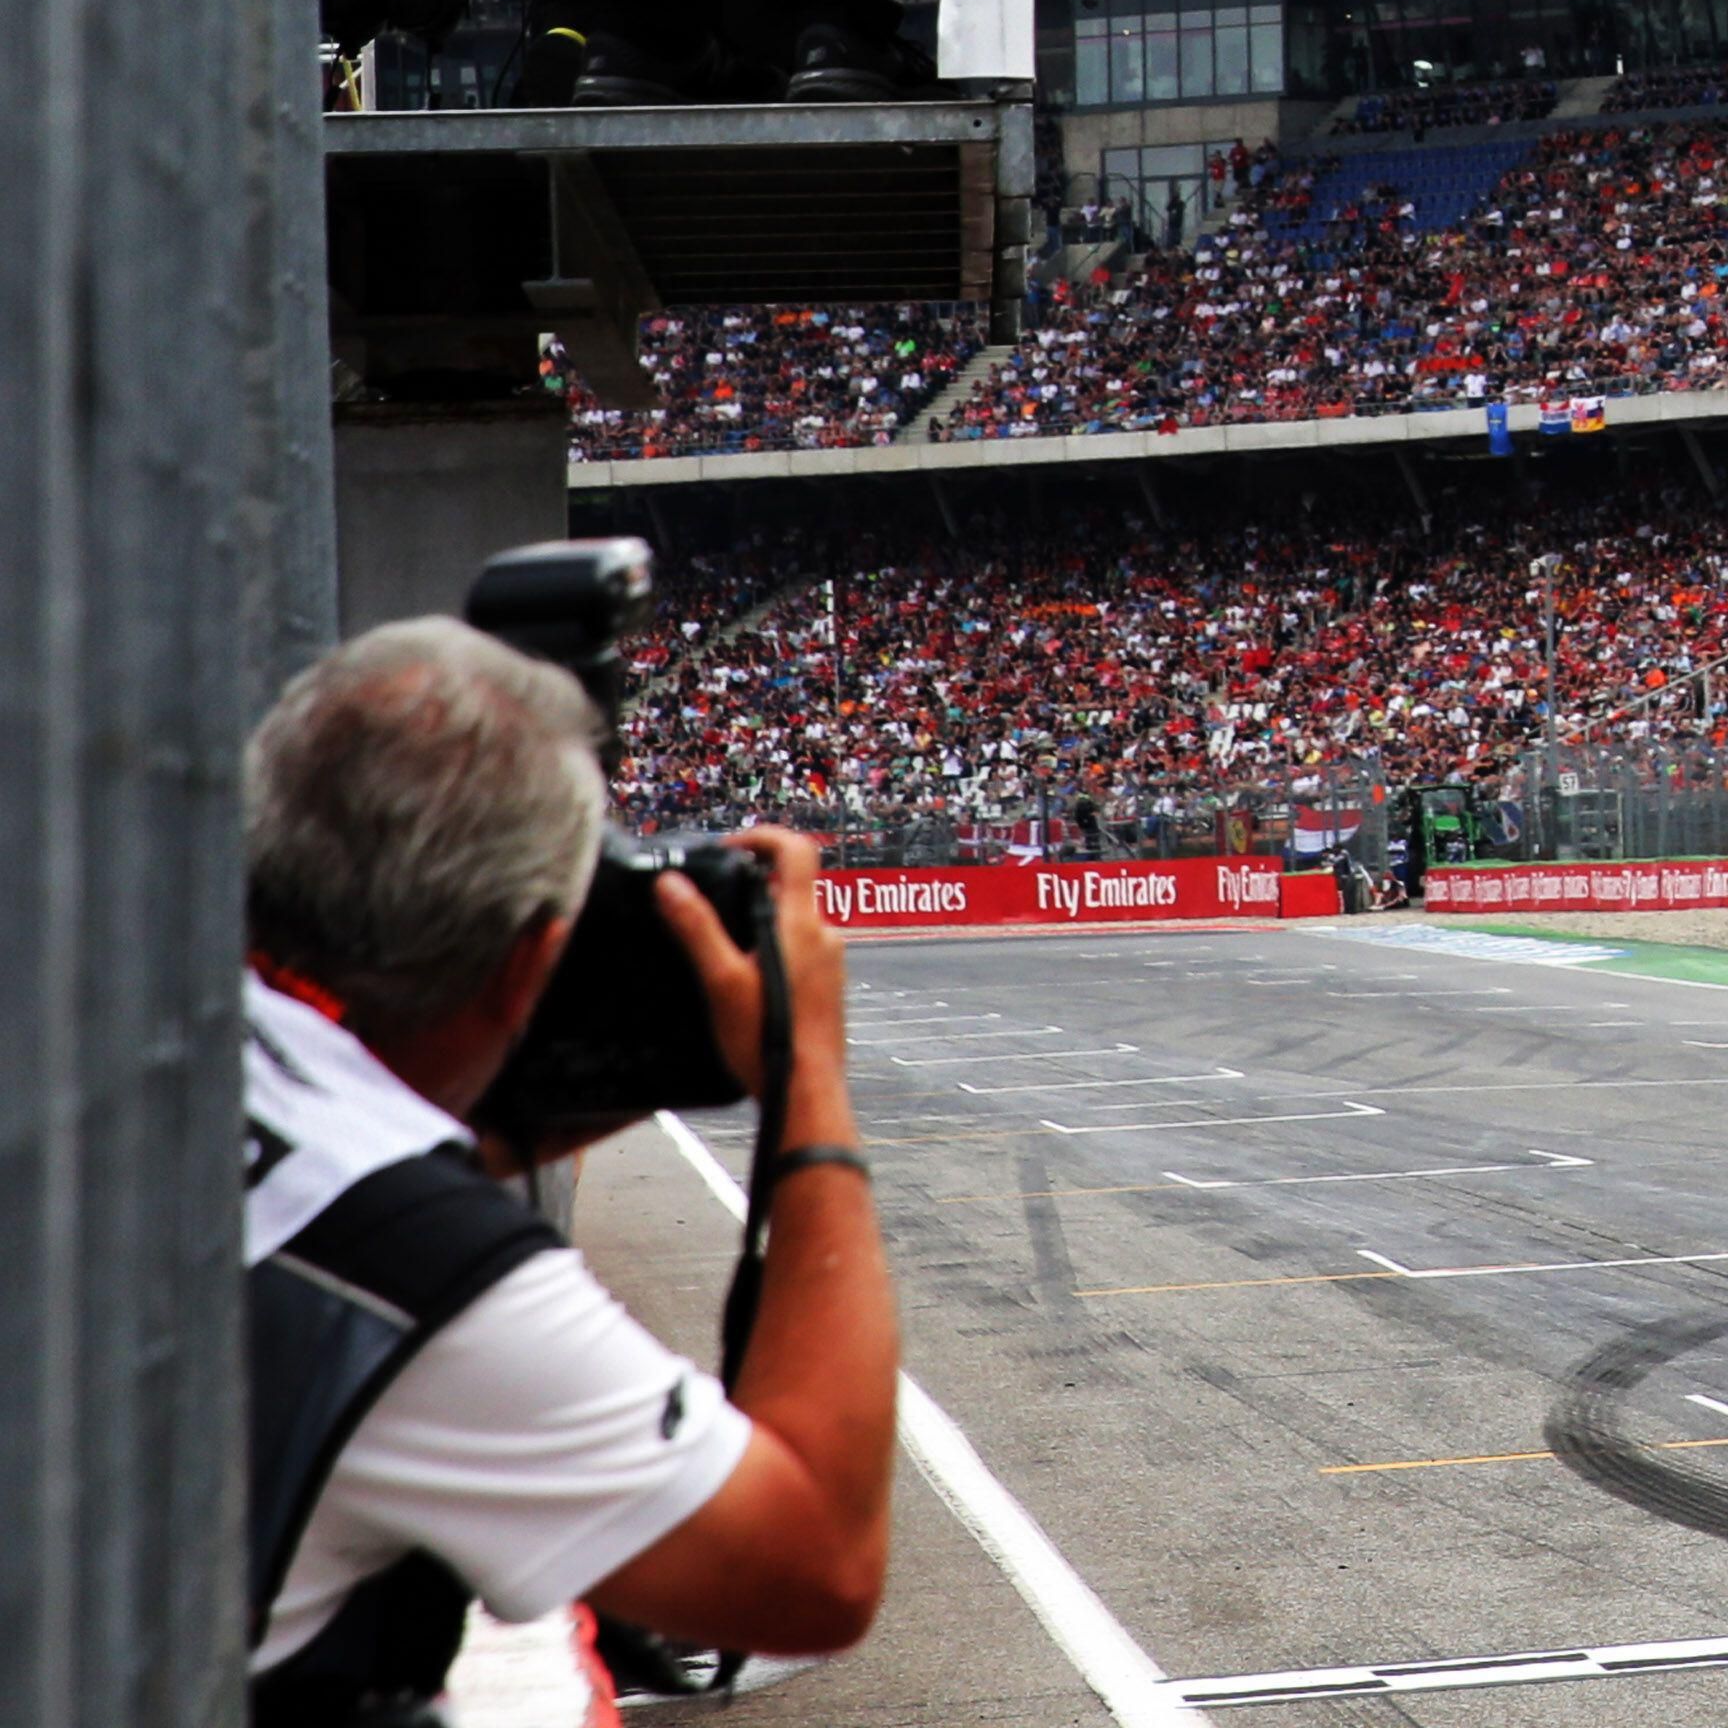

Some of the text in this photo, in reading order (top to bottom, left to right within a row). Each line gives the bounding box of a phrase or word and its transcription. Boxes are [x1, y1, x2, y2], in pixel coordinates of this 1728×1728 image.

[857, 875, 966, 914] Emirates
[1037, 869, 1176, 917] Fly Emirates
